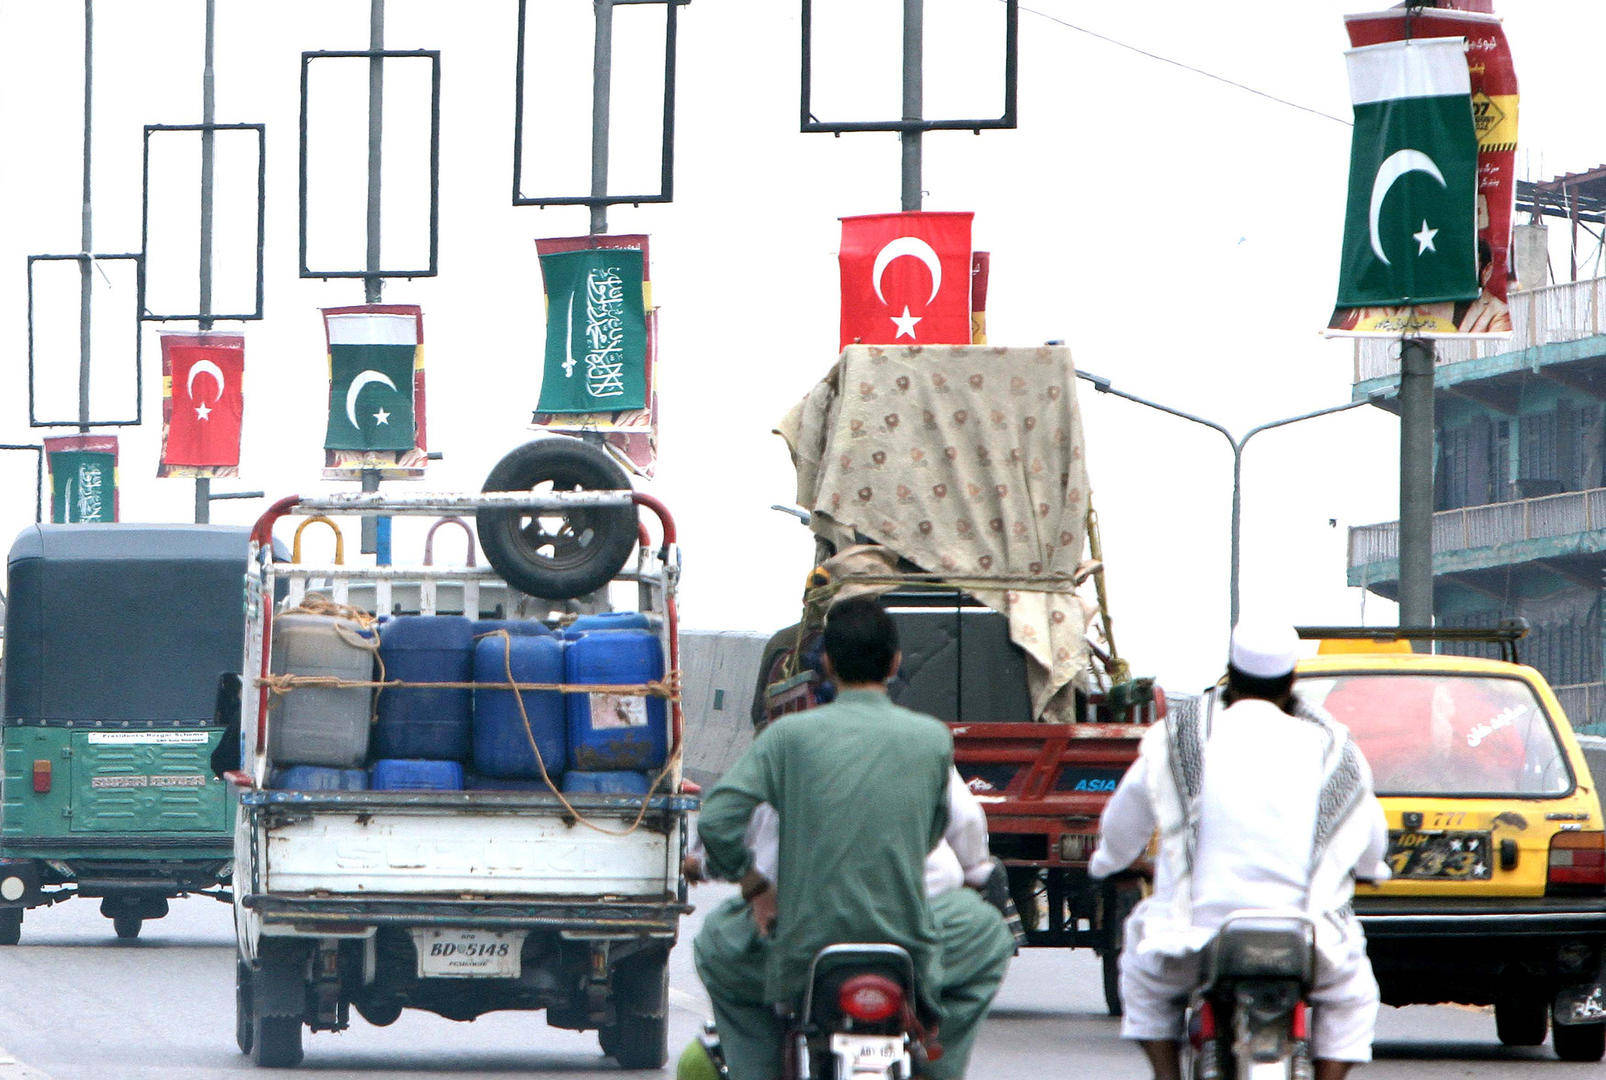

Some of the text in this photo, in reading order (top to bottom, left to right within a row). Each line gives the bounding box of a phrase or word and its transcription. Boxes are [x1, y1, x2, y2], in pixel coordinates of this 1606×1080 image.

[1074, 779, 1117, 792] ASIA
[1433, 812, 1467, 826] 777
[430, 942, 510, 957] BD 5148
